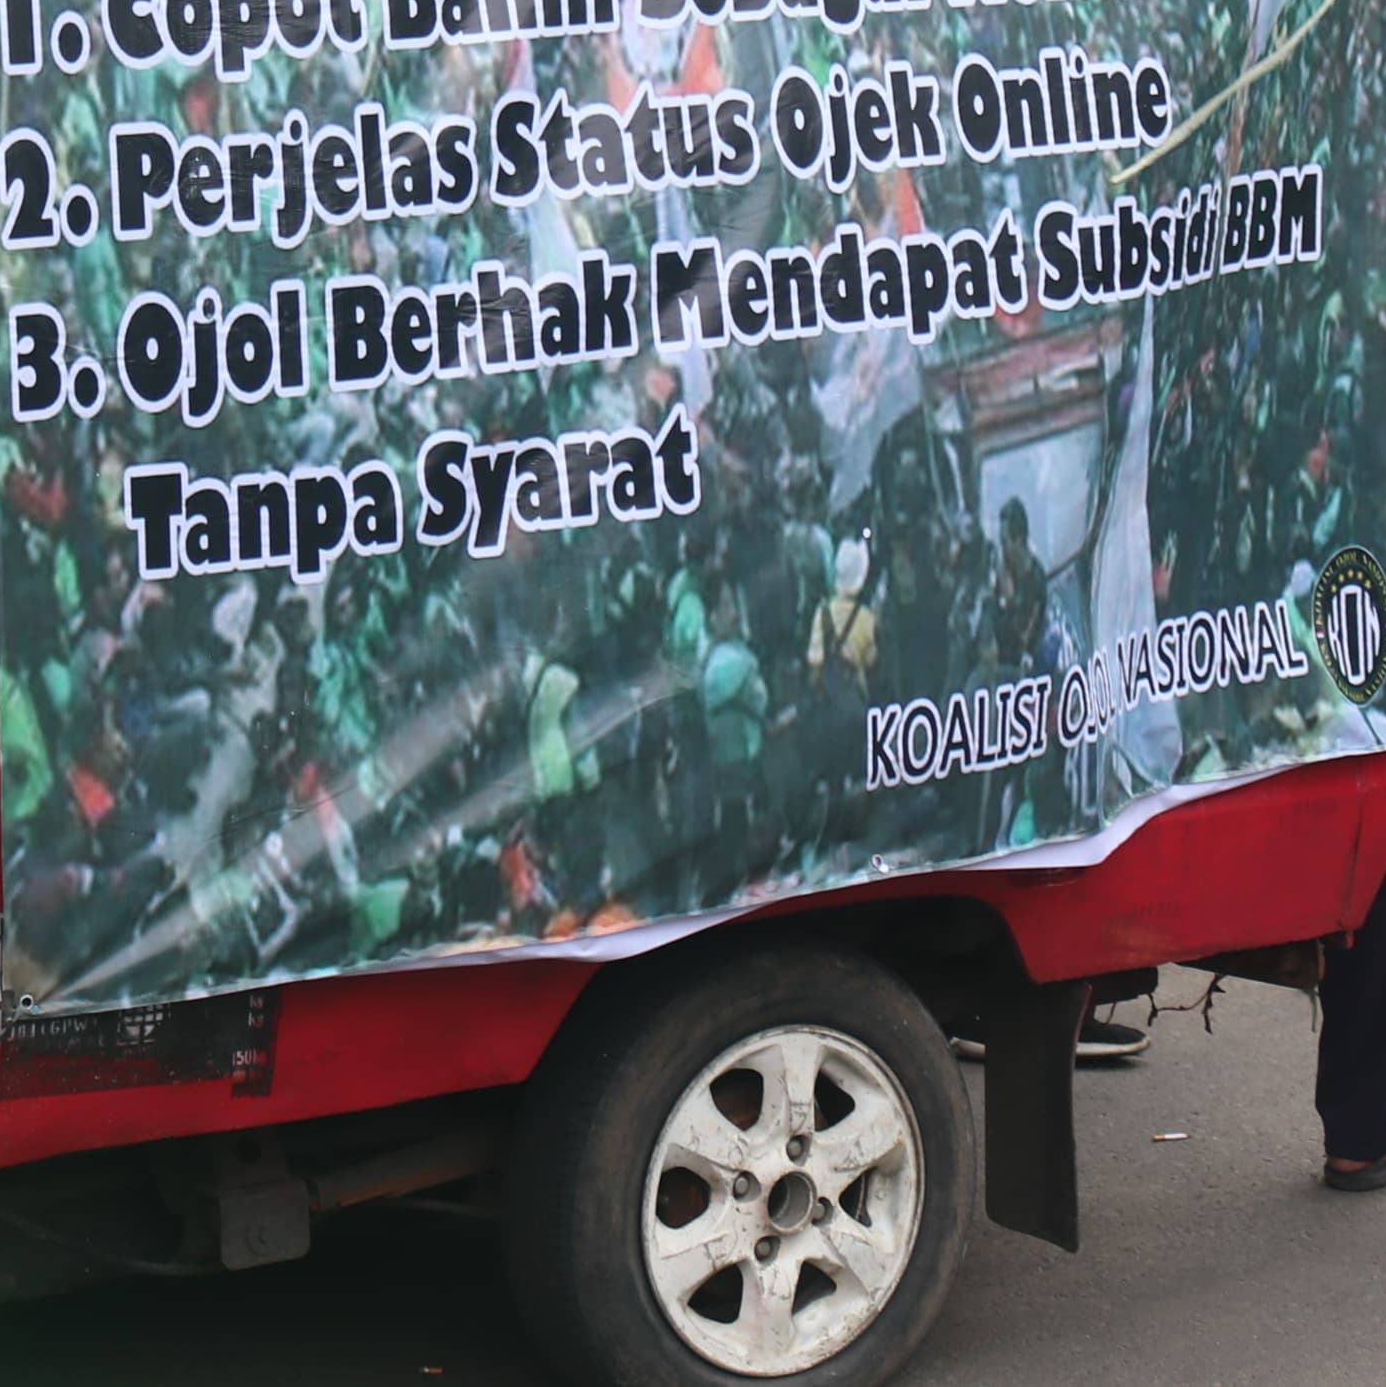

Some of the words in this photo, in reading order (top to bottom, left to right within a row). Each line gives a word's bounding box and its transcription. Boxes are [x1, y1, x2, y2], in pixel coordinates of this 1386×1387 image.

[0, 127, 98, 249] 2.
[110, 102, 476, 249] Perjelas
[490, 81, 761, 206] Status
[771, 59, 946, 193] Ojek
[953, 46, 1173, 163] Online
[10, 302, 106, 422] 3.
[118, 278, 308, 428] Ojol
[326, 250, 636, 391] Berhak
[653, 208, 1027, 352] Mendapat
[1036, 185, 1220, 311] Subsidi
[1220, 164, 1323, 274] BBM
[124, 460, 404, 585] Tanpa
[416, 403, 702, 558] Syarat
[865, 674, 1052, 791] KOALISI
